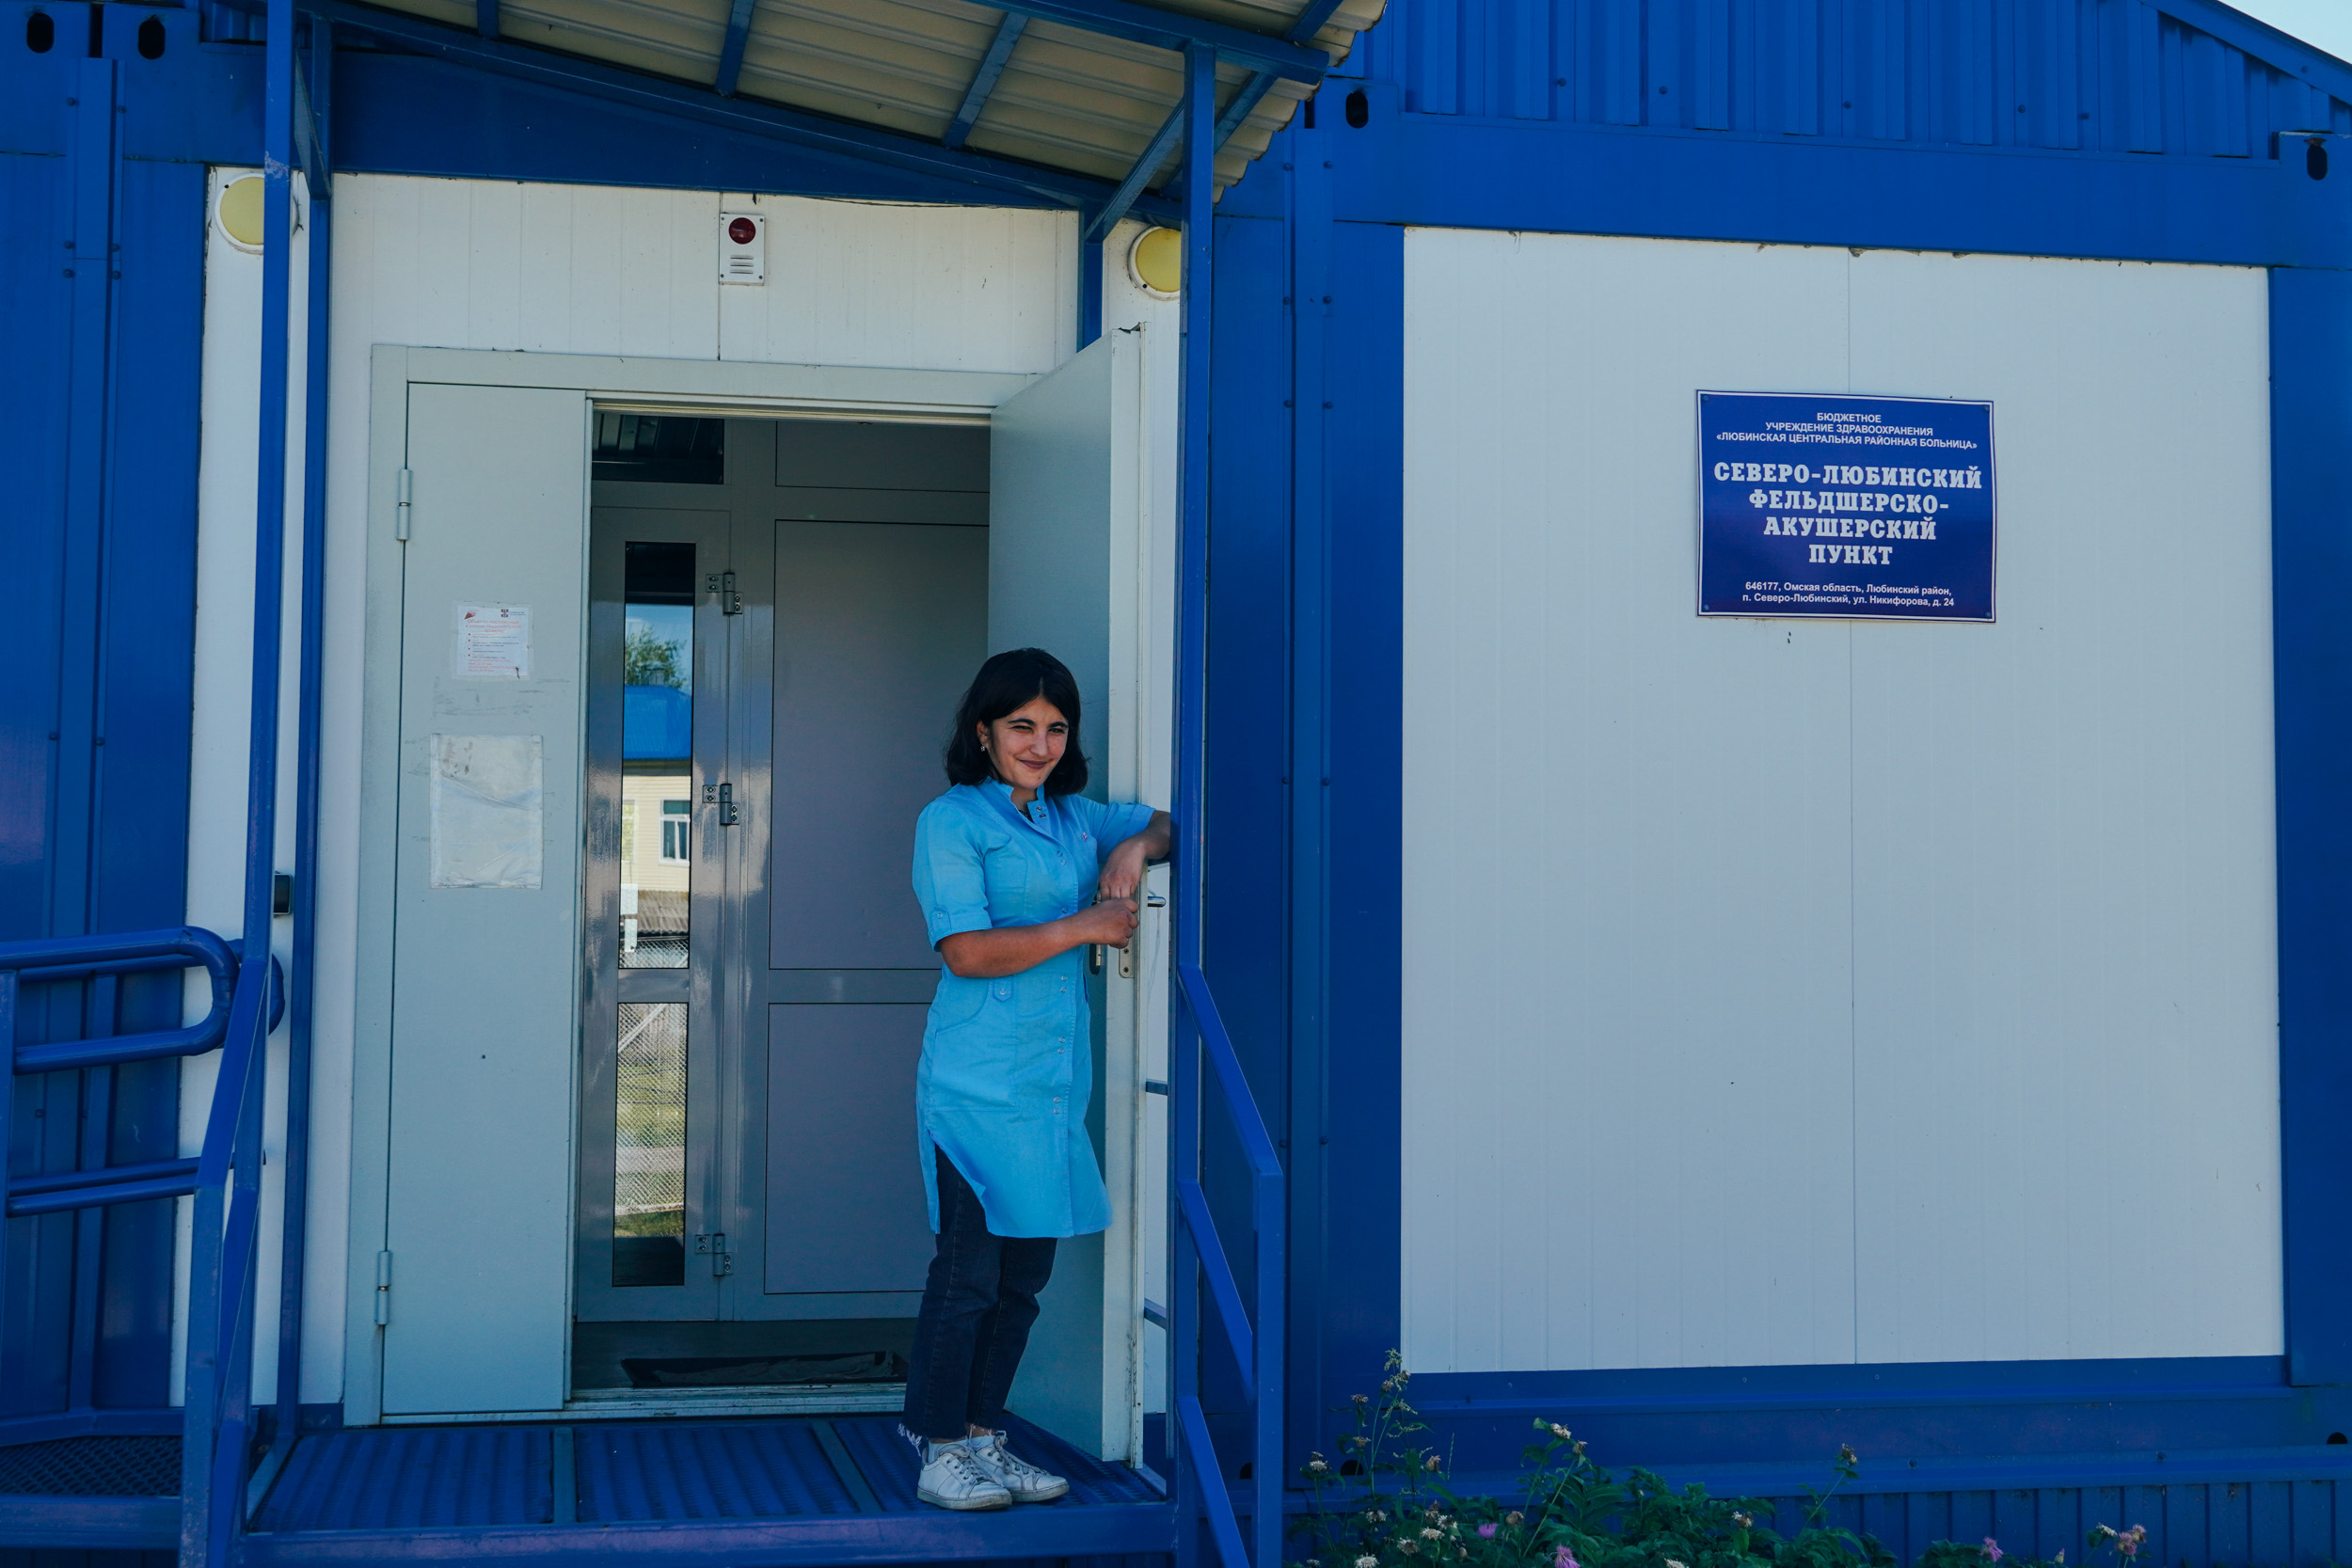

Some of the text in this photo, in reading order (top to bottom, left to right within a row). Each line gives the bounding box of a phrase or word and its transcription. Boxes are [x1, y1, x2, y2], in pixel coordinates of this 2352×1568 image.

[1817, 413, 1882, 423] БЮДЖЕТНОЕ
[1766, 422, 1932, 436] УЧРЕЖДЕНИЕ ЗДРАВООХРАНЕНИЯ
[1716, 432, 1977, 450] «ЛЮБИНСКАЯ ЦЕНТРАЛЬНАЯ РАЙОННАЯ БОЛЬНИЦА»
[1714, 462, 1981, 489] СЕВЕРО-ЛЮБИНСКИЙ
[1749, 489, 1948, 514] ФЕЛЬДШЕРСКО-
[1764, 516, 1936, 540] АКУШЕРСКИЙ
[1809, 545, 1892, 564] ПУНКТ
[1745, 581, 1951, 596] 646177, Омская область, Любинский район,
[1754, 594, 1851, 604] Северо-Любинский,
[1870, 595, 1931, 607] Никифорова,
